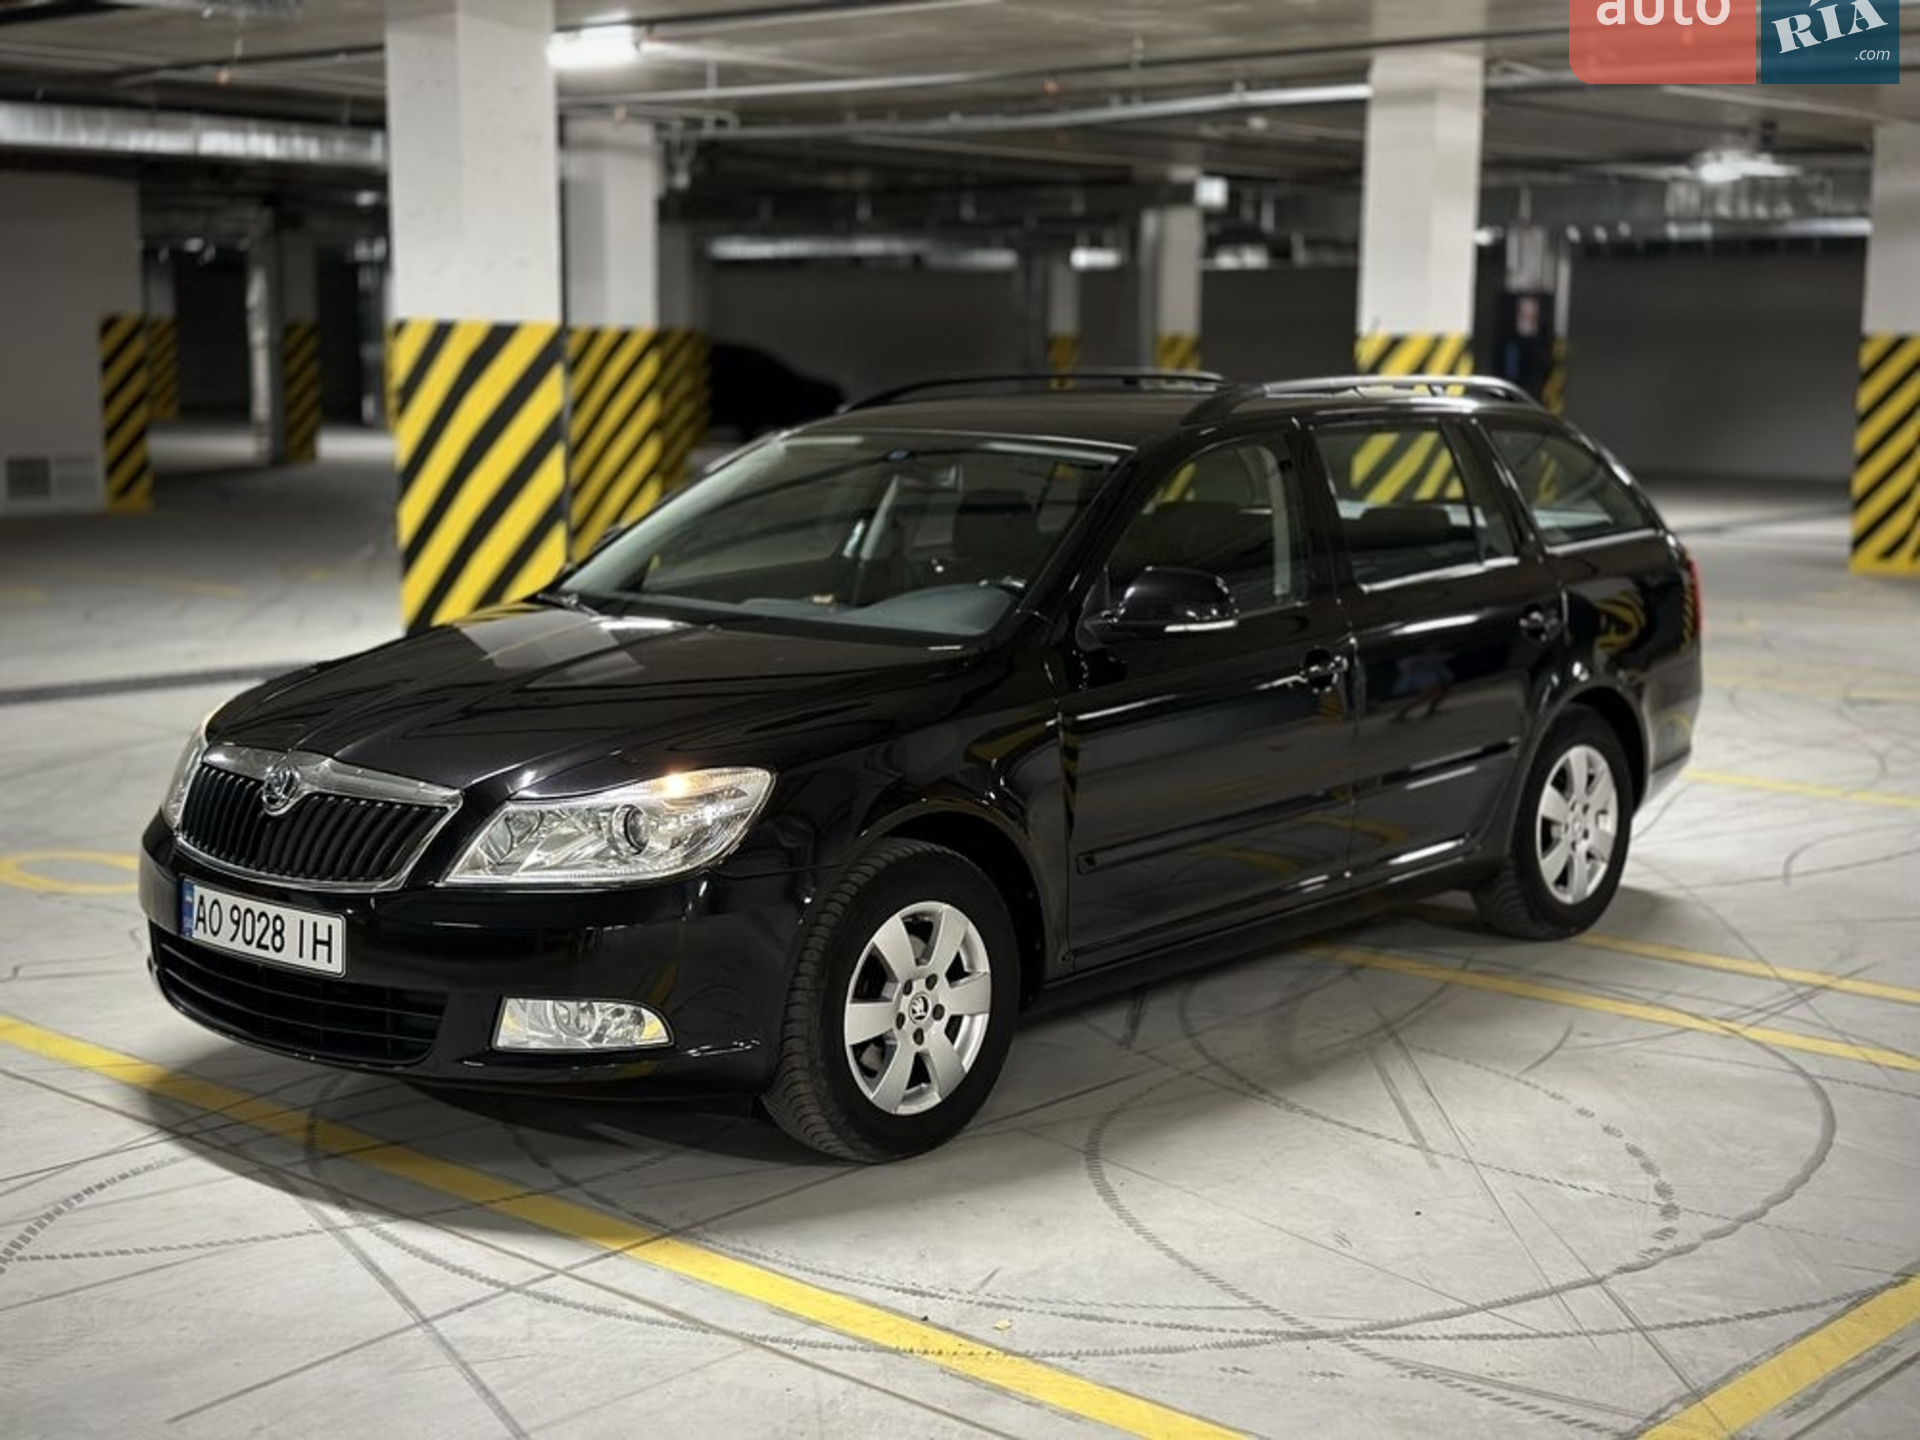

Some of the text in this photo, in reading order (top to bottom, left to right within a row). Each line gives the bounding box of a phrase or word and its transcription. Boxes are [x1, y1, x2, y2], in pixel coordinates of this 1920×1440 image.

[195, 894, 333, 964] AO 9028 IH
